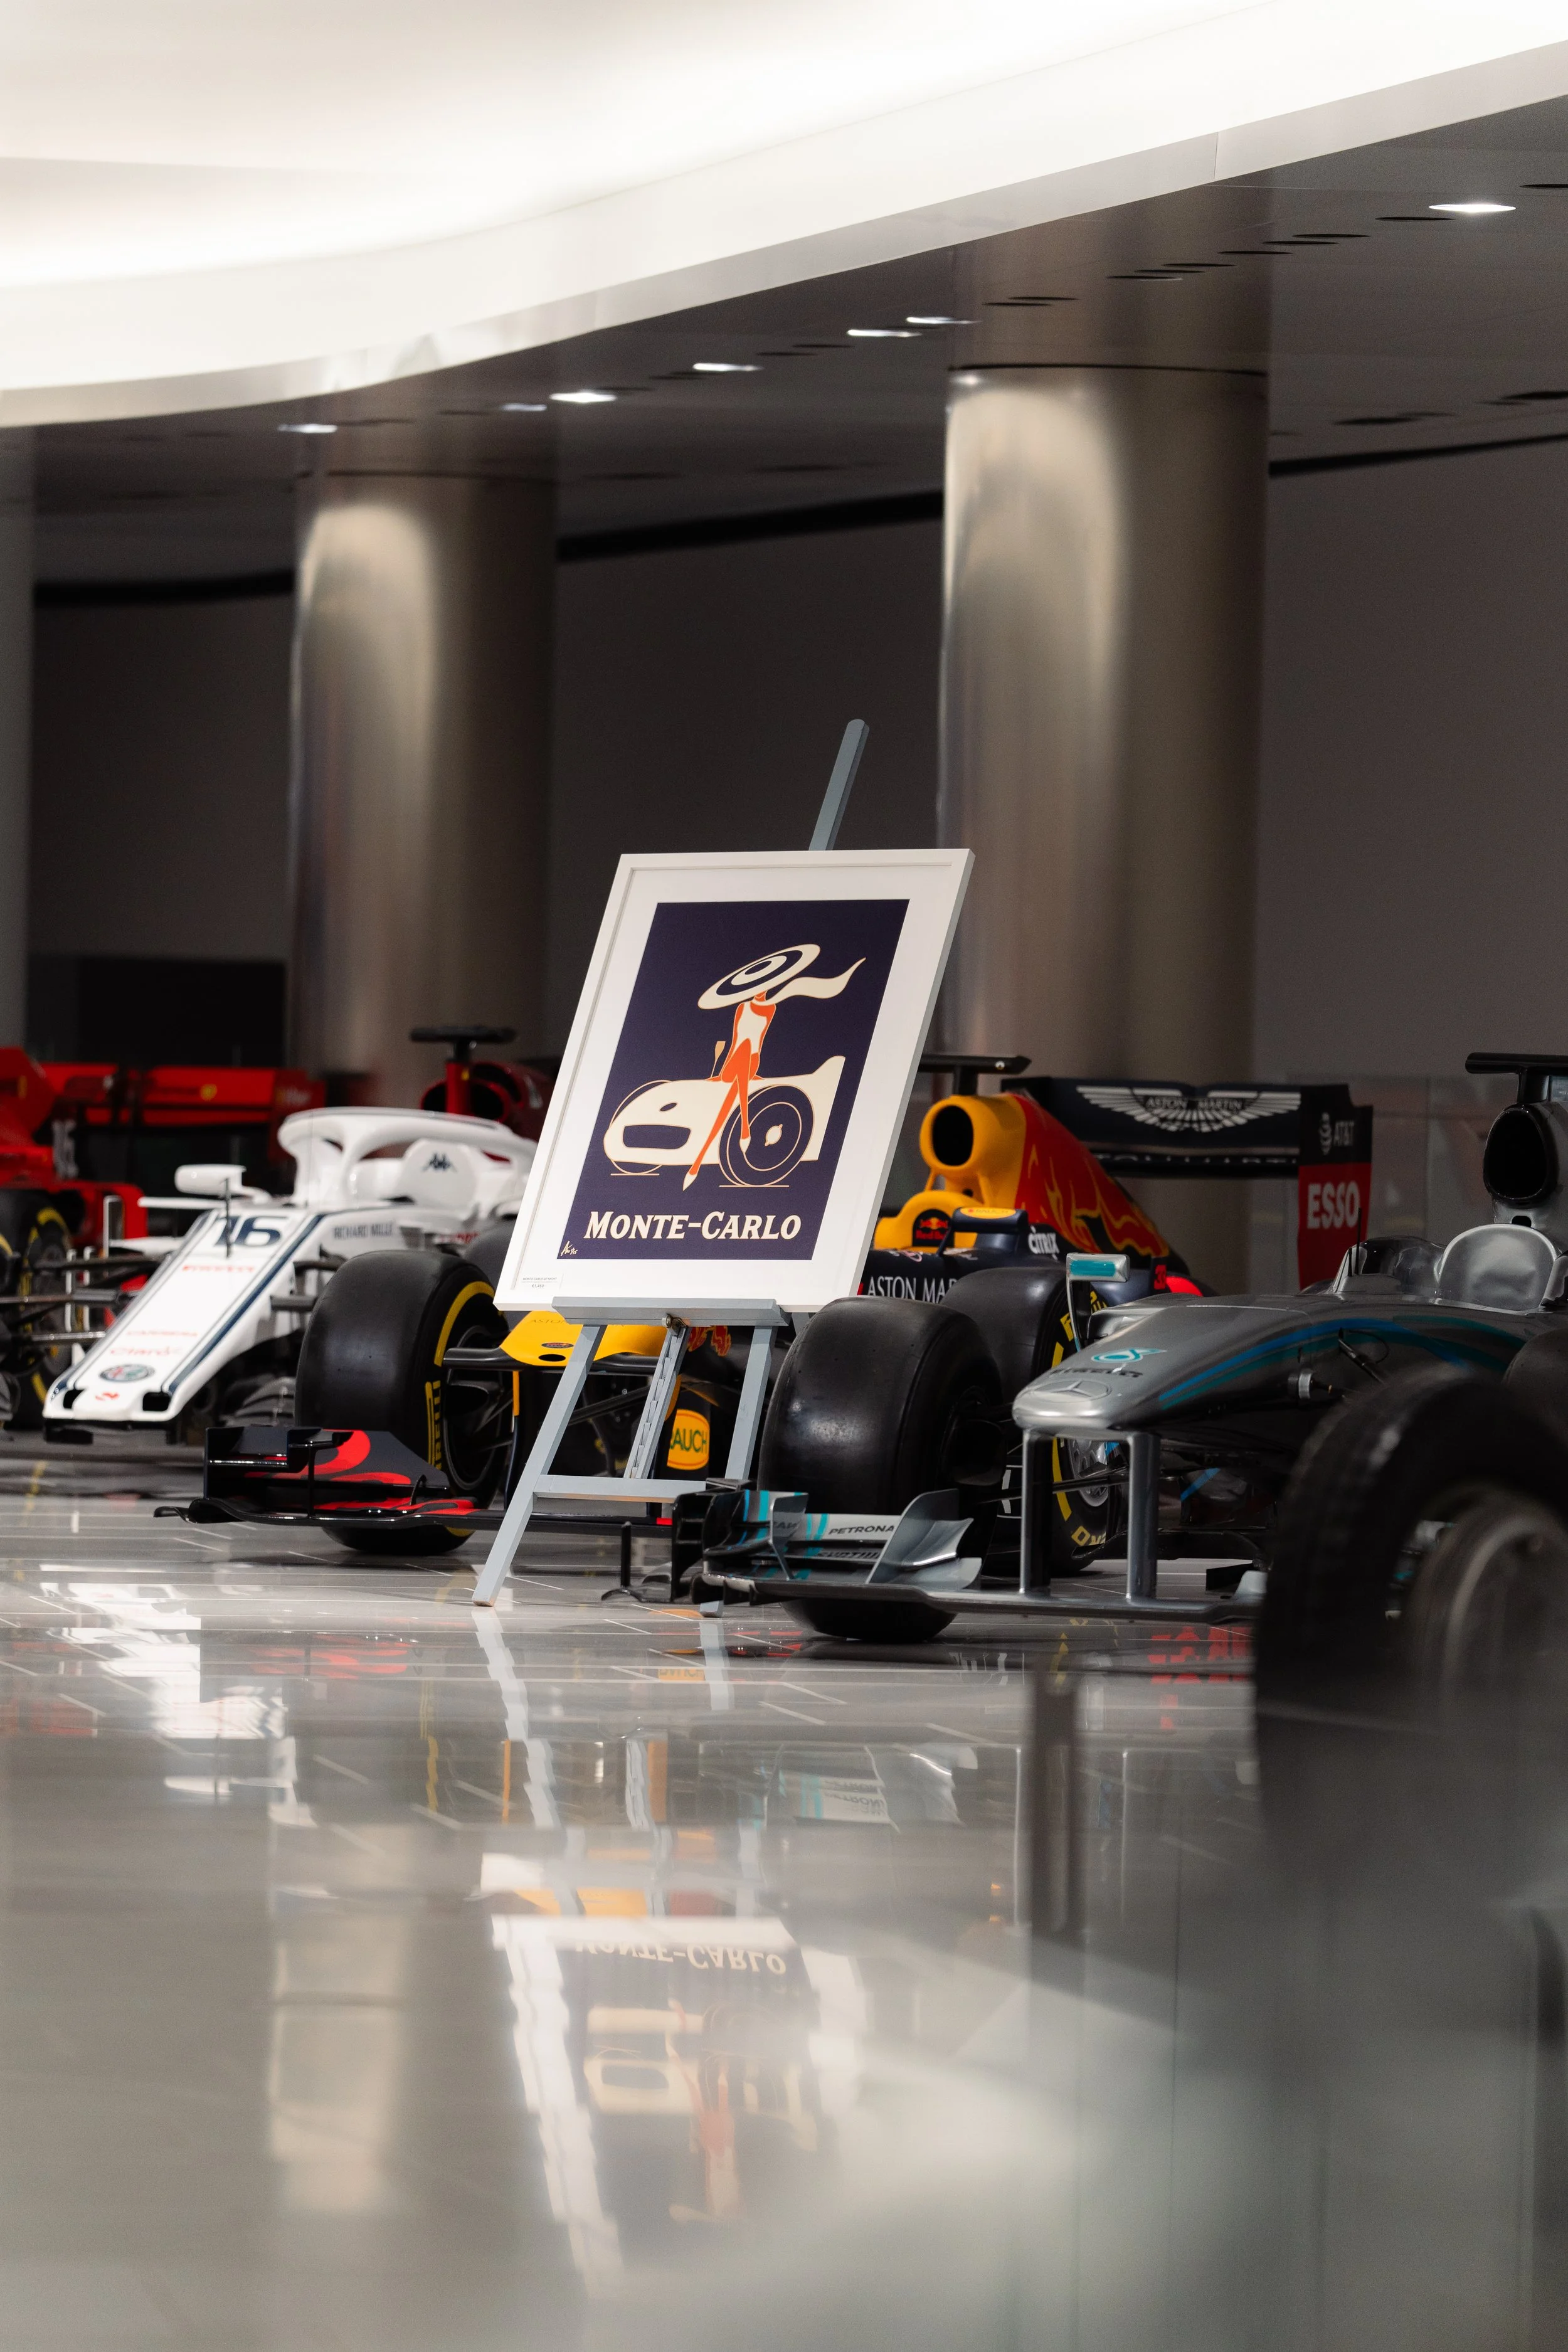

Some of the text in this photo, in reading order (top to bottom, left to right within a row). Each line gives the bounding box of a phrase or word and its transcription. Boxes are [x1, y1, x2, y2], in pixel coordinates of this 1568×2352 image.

[1307, 1182, 1360, 1229] ESSO
[214, 1216, 281, 1246] 16
[583, 1211, 802, 1240] MONTE-CARLO
[868, 1276, 916, 1300] ASTON
